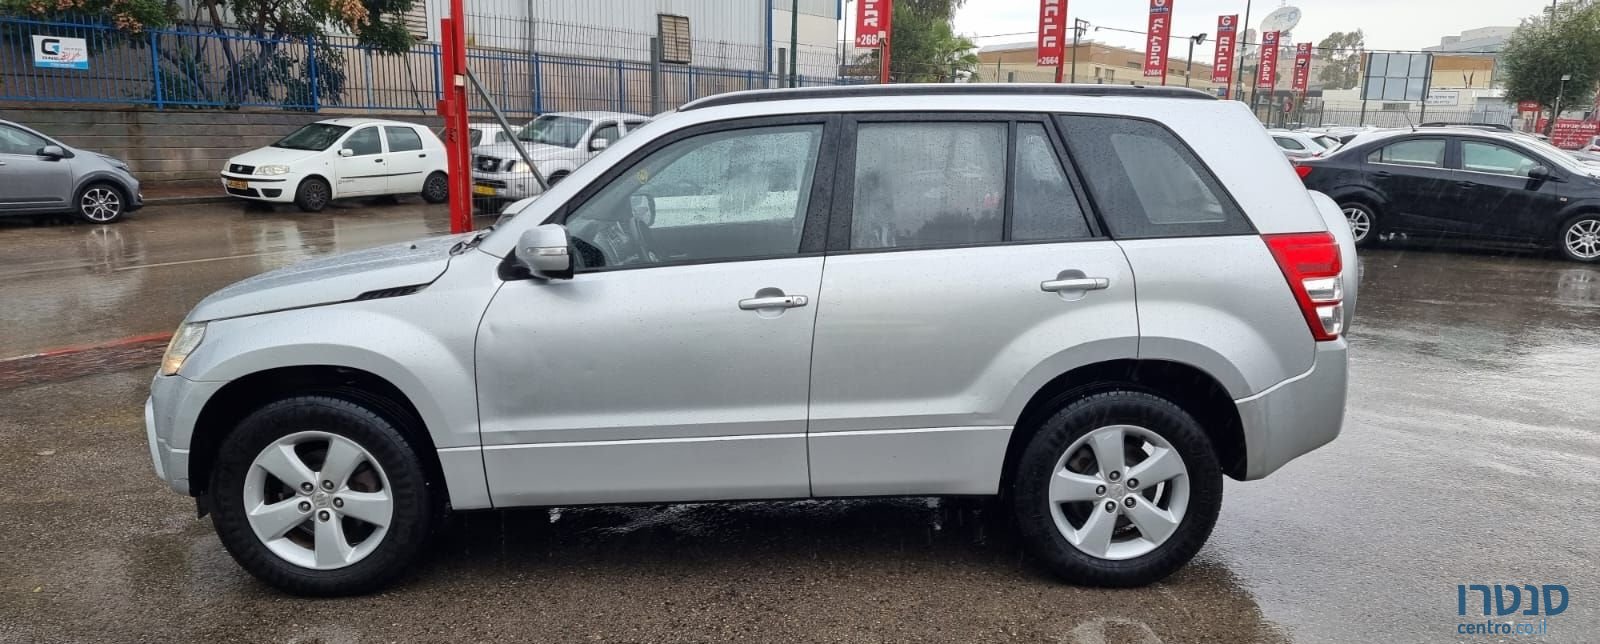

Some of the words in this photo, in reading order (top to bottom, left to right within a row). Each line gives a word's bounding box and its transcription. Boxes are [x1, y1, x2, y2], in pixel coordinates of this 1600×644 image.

[1221, 16, 1231, 25] G
[1265, 32, 1274, 40] G
[1217, 36, 1230, 71] מכירה
